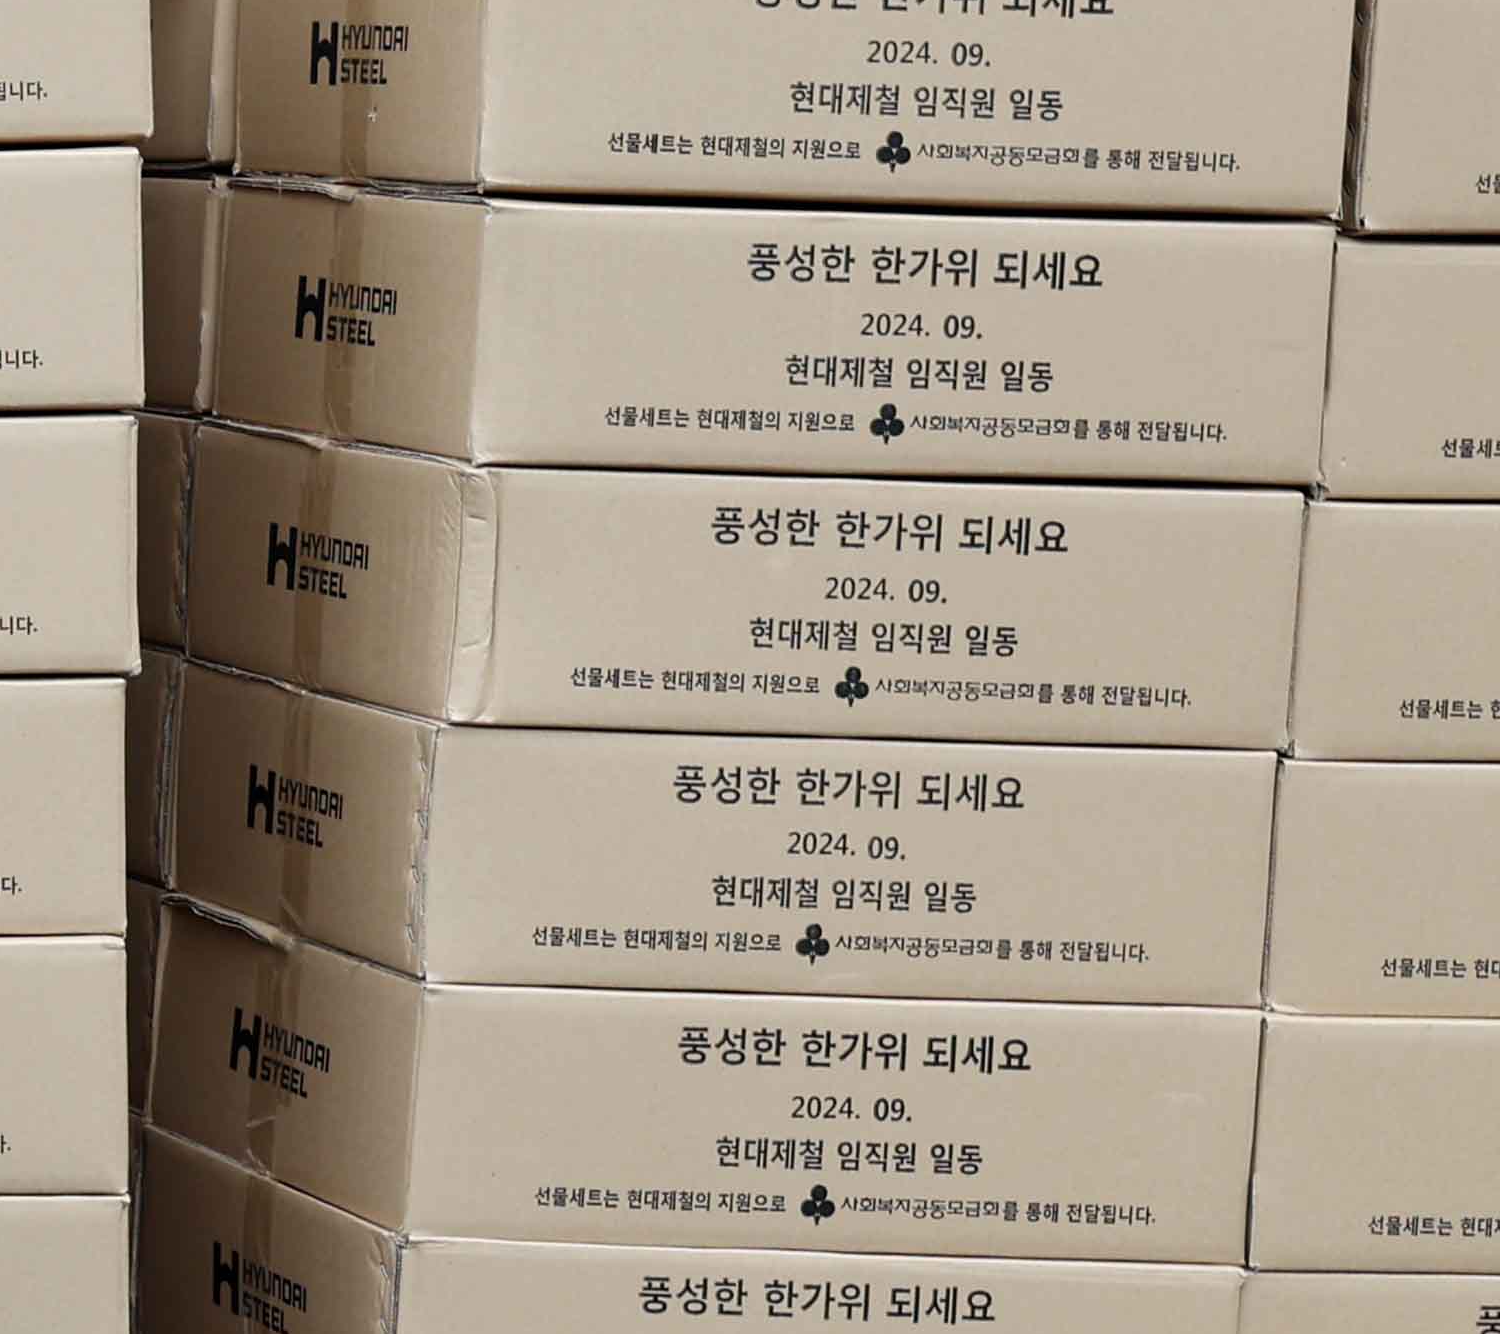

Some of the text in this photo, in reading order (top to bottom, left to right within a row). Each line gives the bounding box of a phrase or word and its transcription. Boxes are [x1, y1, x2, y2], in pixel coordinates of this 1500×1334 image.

[342, 25, 409, 53] HYUNDAI
[340, 58, 388, 86] STEEL
[299, 534, 369, 570] HYUNDAI
[298, 564, 348, 600] STEEL
[264, 1023, 331, 1072] HYUNDAI
[261, 1059, 308, 1098] STEEL
[638, 1276, 996, 1326] 풍성한 한가위 되세요
